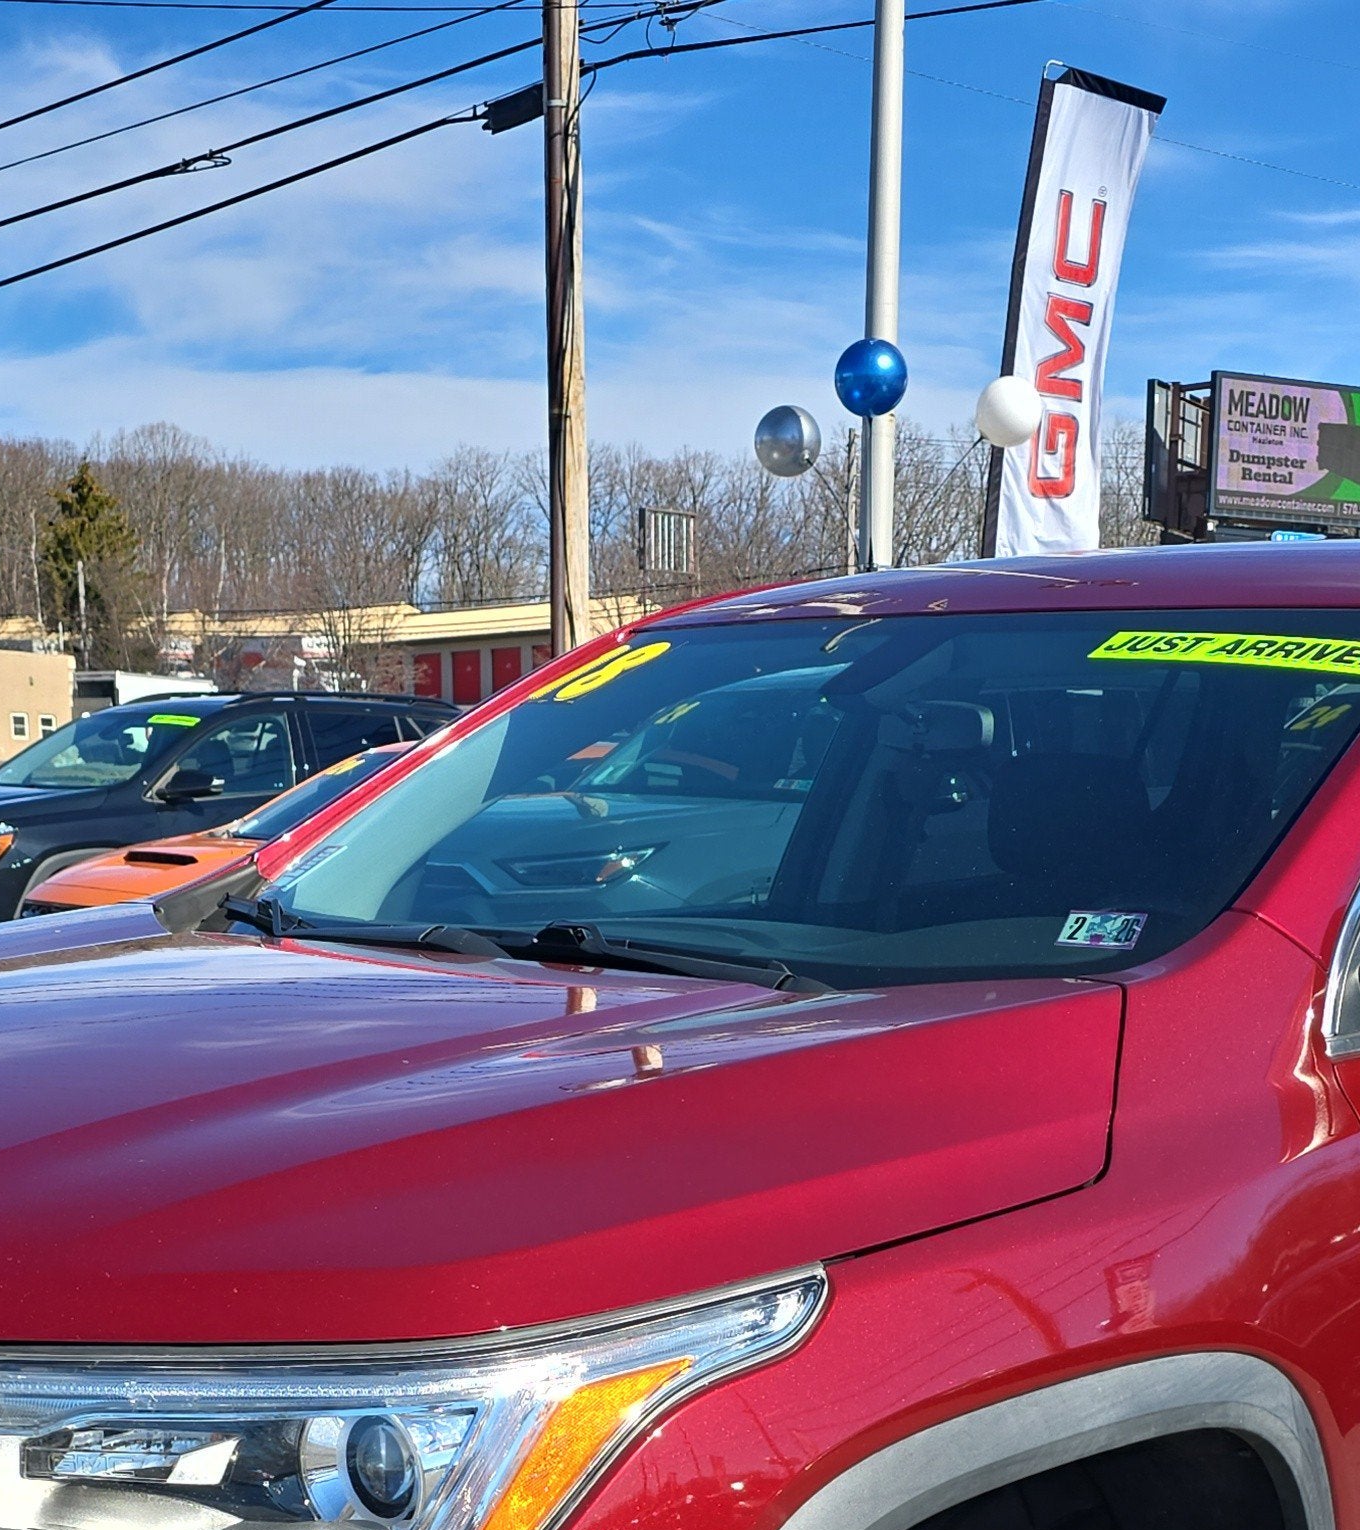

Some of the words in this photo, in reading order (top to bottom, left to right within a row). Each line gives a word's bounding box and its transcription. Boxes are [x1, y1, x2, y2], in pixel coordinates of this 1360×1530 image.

[1028, 189, 1107, 498] GMC
[1227, 389, 1310, 423] MEADOW
[1227, 420, 1286, 437] CONTAINER
[1229, 449, 1307, 470] Dumpster
[1241, 467, 1294, 485] Rental
[1103, 635, 1215, 654] JUST
